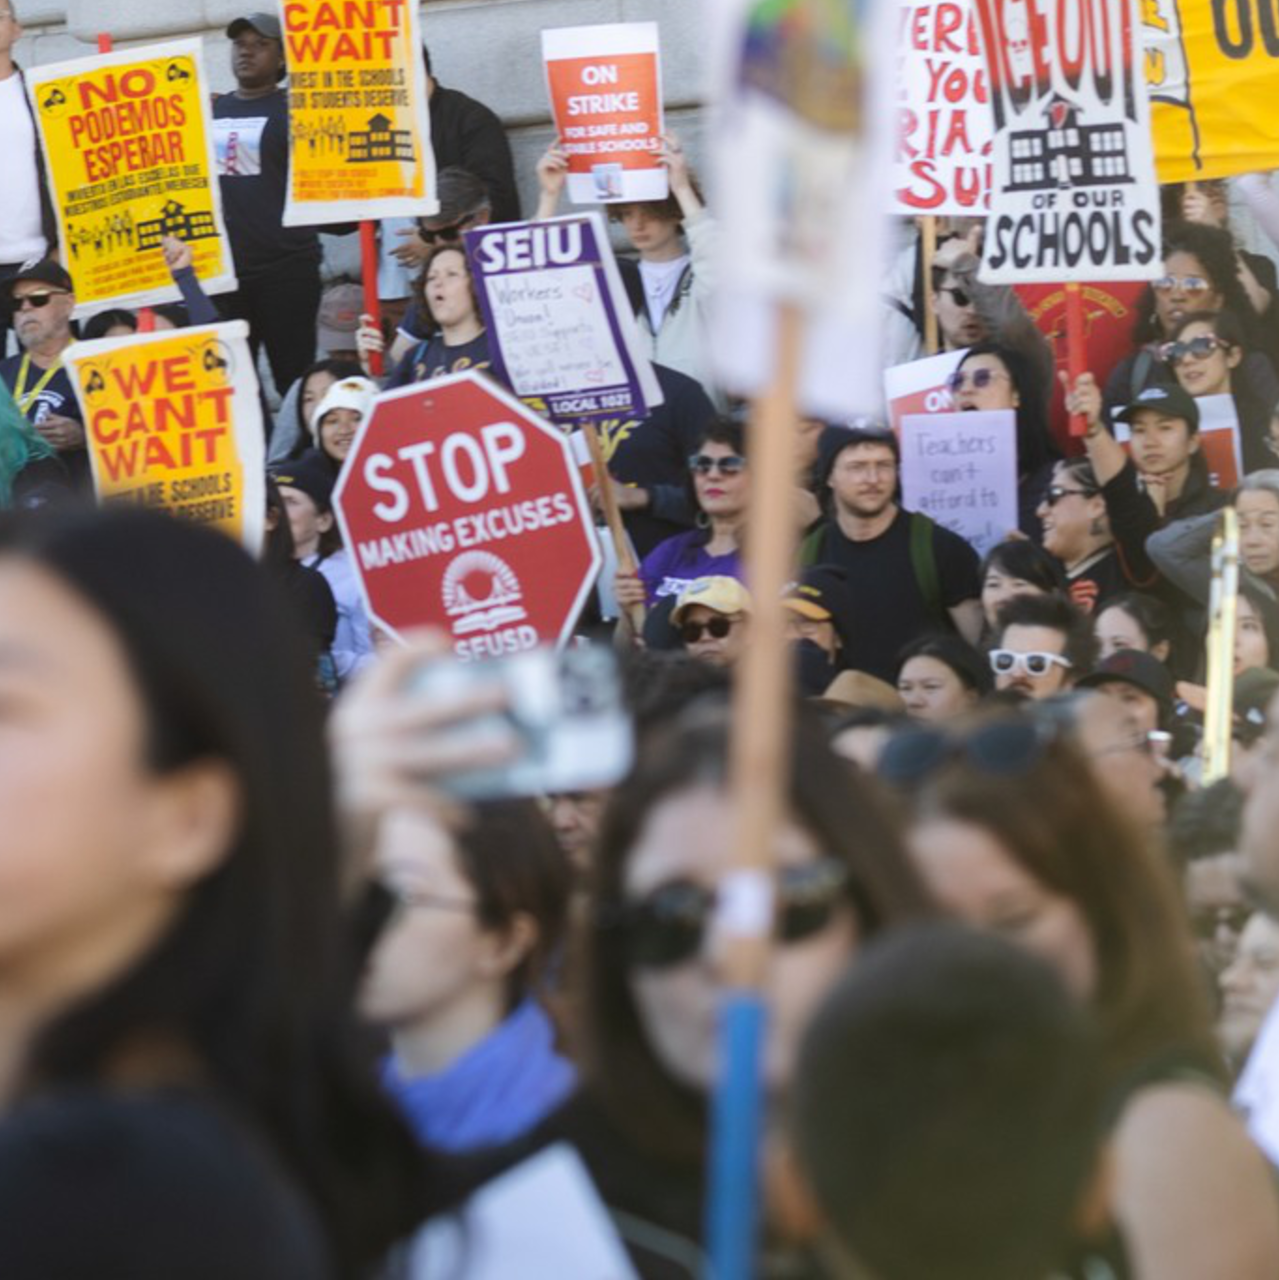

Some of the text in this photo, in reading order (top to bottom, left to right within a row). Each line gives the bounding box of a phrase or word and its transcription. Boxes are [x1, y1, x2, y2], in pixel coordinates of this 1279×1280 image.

[287, 31, 399, 63] WAIT
[78, 68, 155, 110] NO
[581, 65, 617, 86] ON
[311, 90, 361, 108] STUDENTS
[567, 92, 639, 116] STRIKE
[68, 94, 187, 149] PODEMOS
[564, 122, 649, 138] FOR SAFE AND
[83, 131, 186, 183] ESPERAR
[597, 137, 659, 153] SCHOOLS
[1031, 190, 1124, 210] OF OUR
[480, 222, 582, 273] SEIU
[988, 209, 1155, 270] SCHOOLS
[113, 355, 196, 401] WE
[92, 387, 235, 445] CAN'T
[552, 393, 632, 414] LOCAL 1021
[100, 428, 226, 483] WAIT
[916, 432, 997, 457] Teachers
[171, 472, 232, 503] SCHOOLS
[363, 421, 526, 522] STOP
[918, 488, 998, 509] afford to
[358, 492, 574, 570] MAKING EXCUSES
